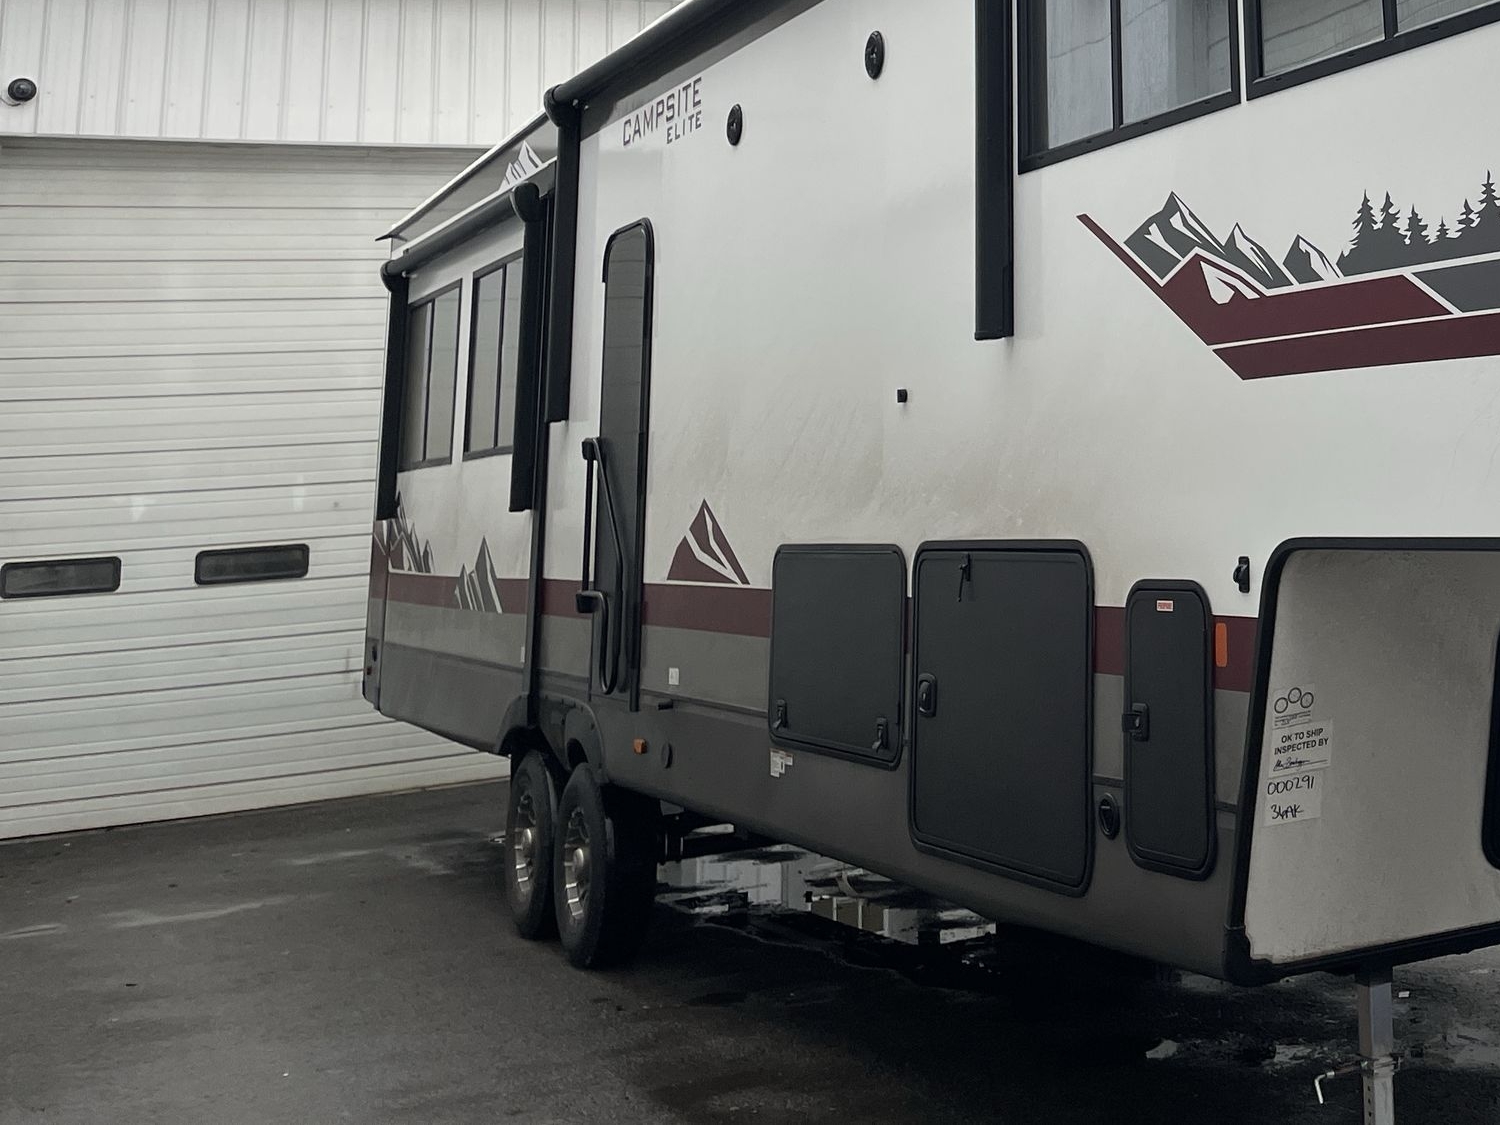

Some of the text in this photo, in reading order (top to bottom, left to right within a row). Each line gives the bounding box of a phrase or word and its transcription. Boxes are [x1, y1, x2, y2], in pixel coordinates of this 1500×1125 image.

[623, 76, 702, 147] CAMPSITE
[666, 109, 702, 145] ELITE
[1281, 728, 1324, 743] OK TO SHIP
[1274, 737, 1329, 755] INSPECTED BY
[1267, 775, 1315, 795] 000291
